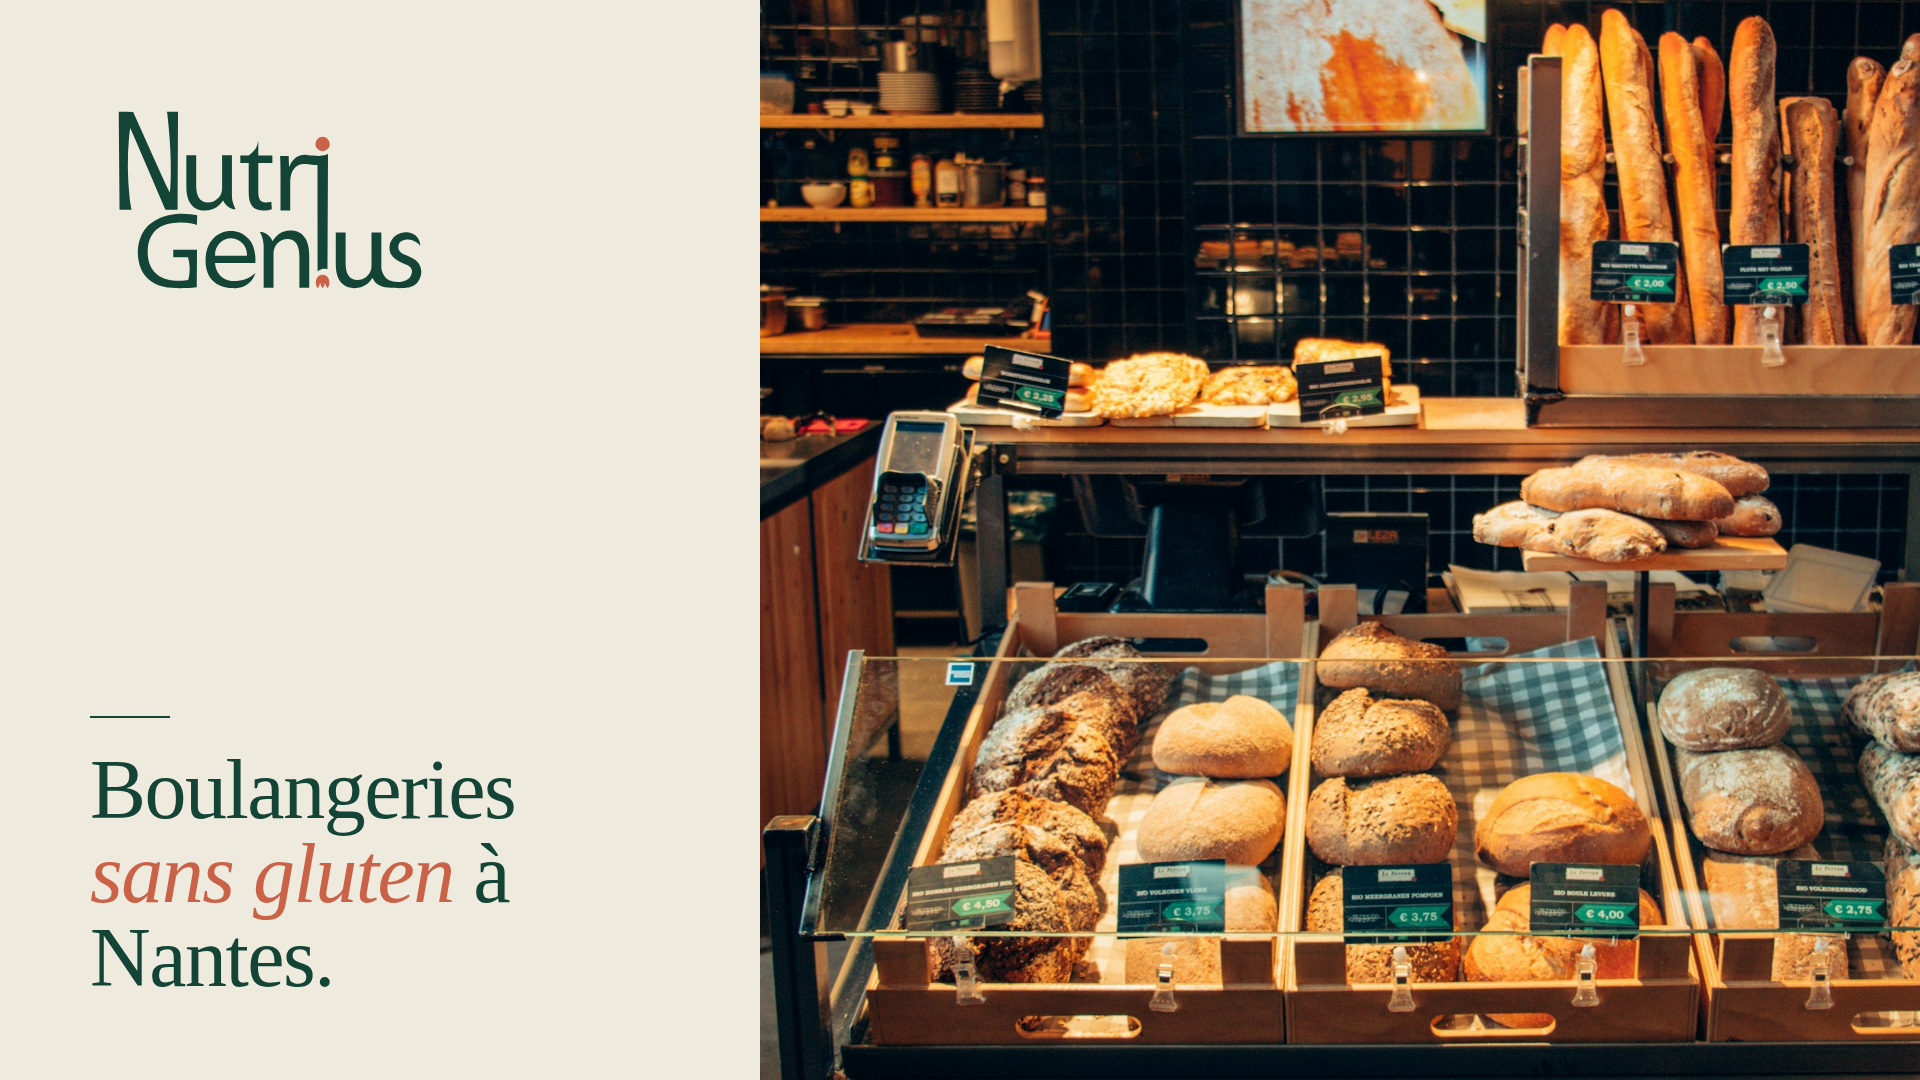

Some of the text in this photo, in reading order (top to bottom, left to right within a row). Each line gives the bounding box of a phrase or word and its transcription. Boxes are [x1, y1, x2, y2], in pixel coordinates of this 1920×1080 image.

[1634, 279, 1665, 288] € 2,00
[1776, 282, 1798, 290] 2,50
[1023, 390, 1054, 402] € 2,25
[1352, 394, 1373, 403] 2,95
[925, 888, 953, 896] DONKER
[954, 882, 999, 892] MEERGRANEN
[962, 899, 1000, 911] € 4,50
[1835, 905, 1873, 915] € 2,75
[1173, 906, 1210, 917] € 3,75
[1586, 909, 1624, 920] € 4,00
[1400, 912, 1437, 923] € 3,75
